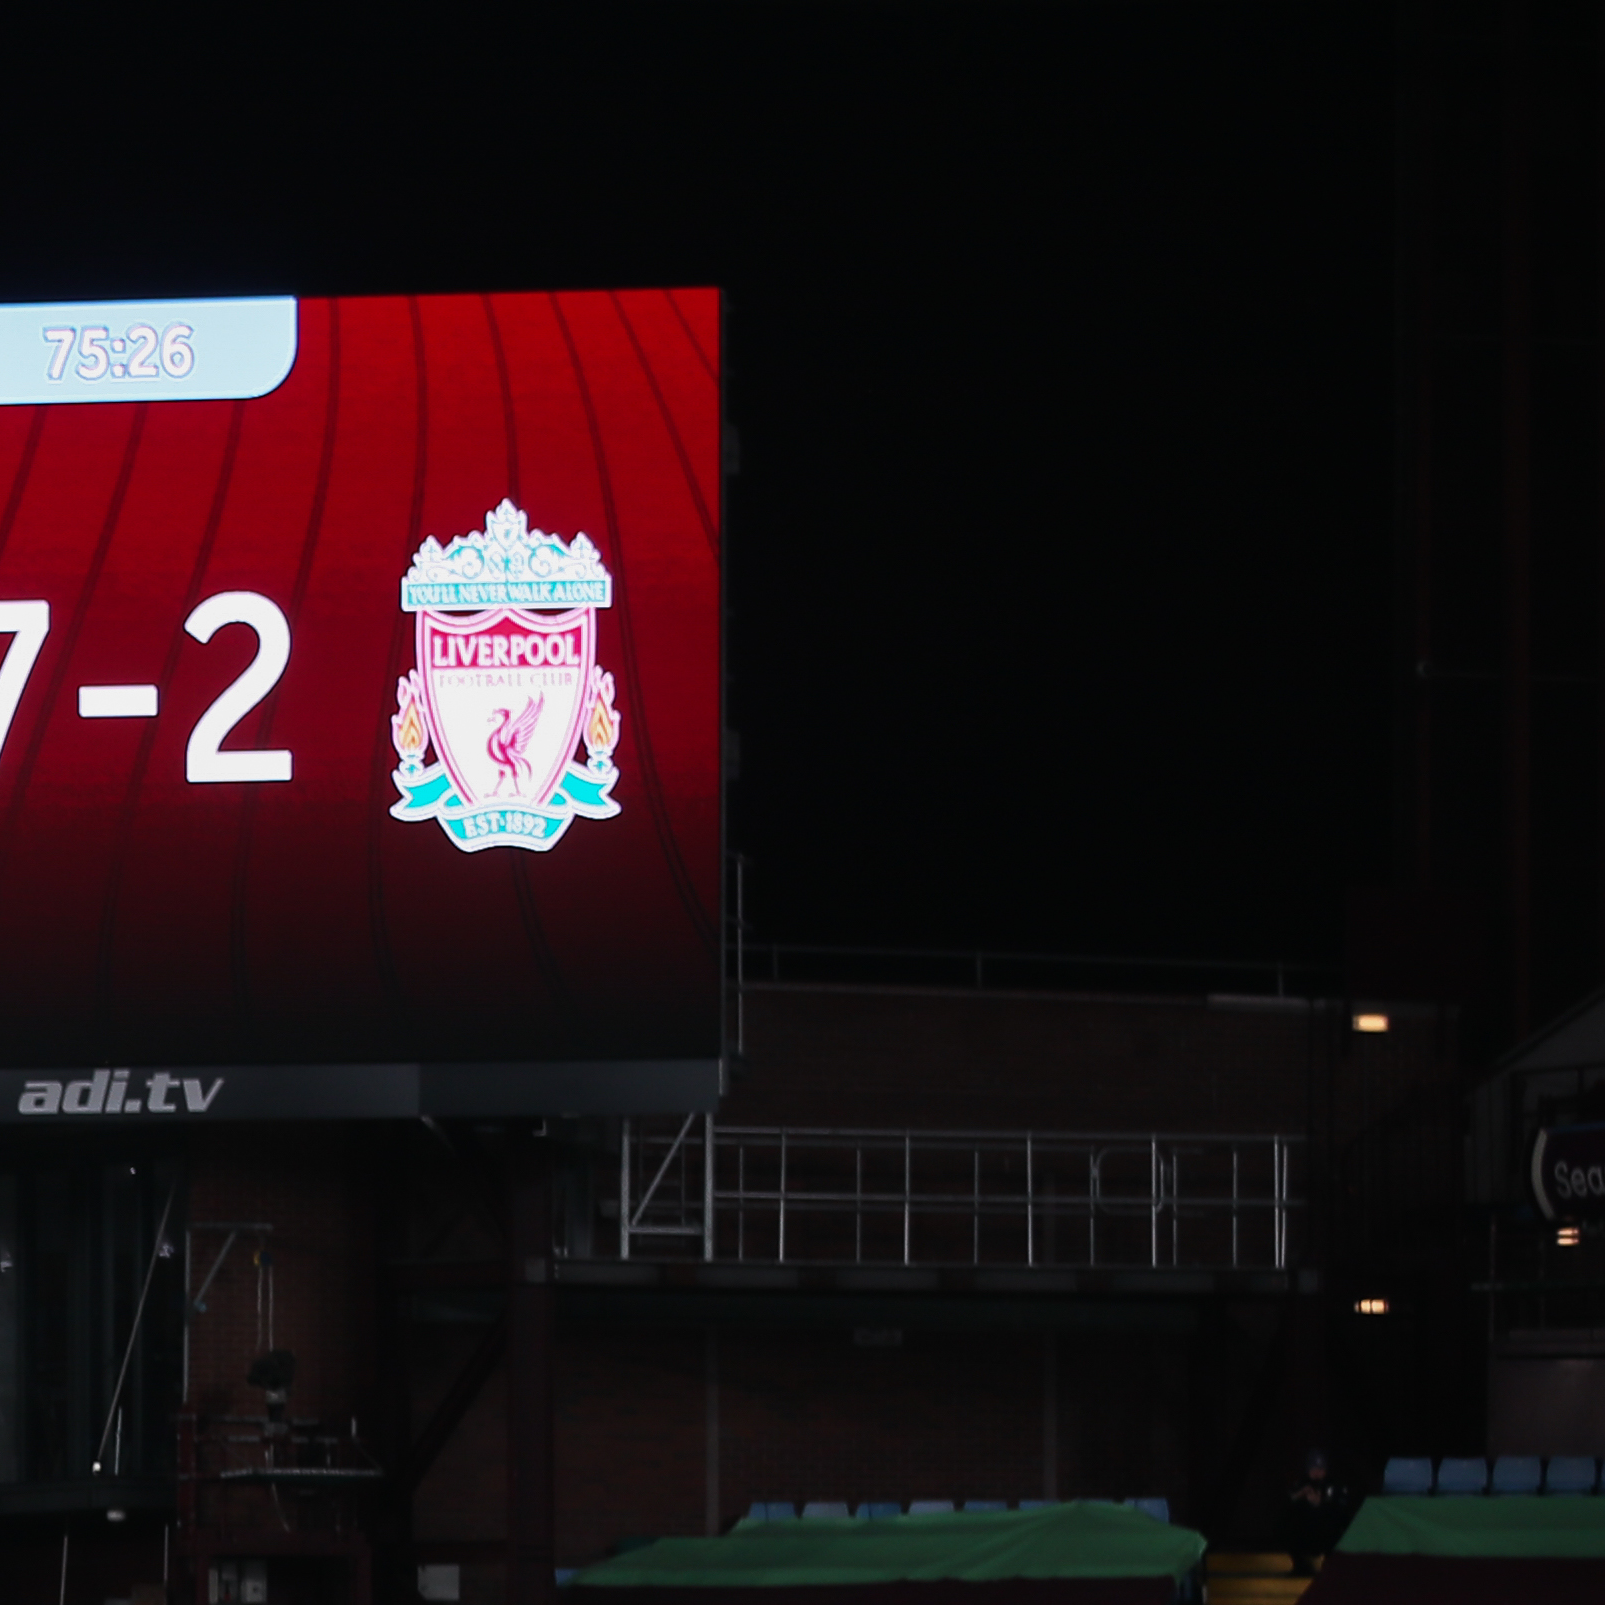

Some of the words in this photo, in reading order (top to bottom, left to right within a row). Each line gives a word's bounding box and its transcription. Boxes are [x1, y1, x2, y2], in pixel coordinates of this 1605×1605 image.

[42, 322, 194, 380] 75:26
[432, 634, 580, 667] LIVERPOOL
[18, 1068, 225, 1114] adi.tv
[1554, 1160, 1605, 1200] Sea
